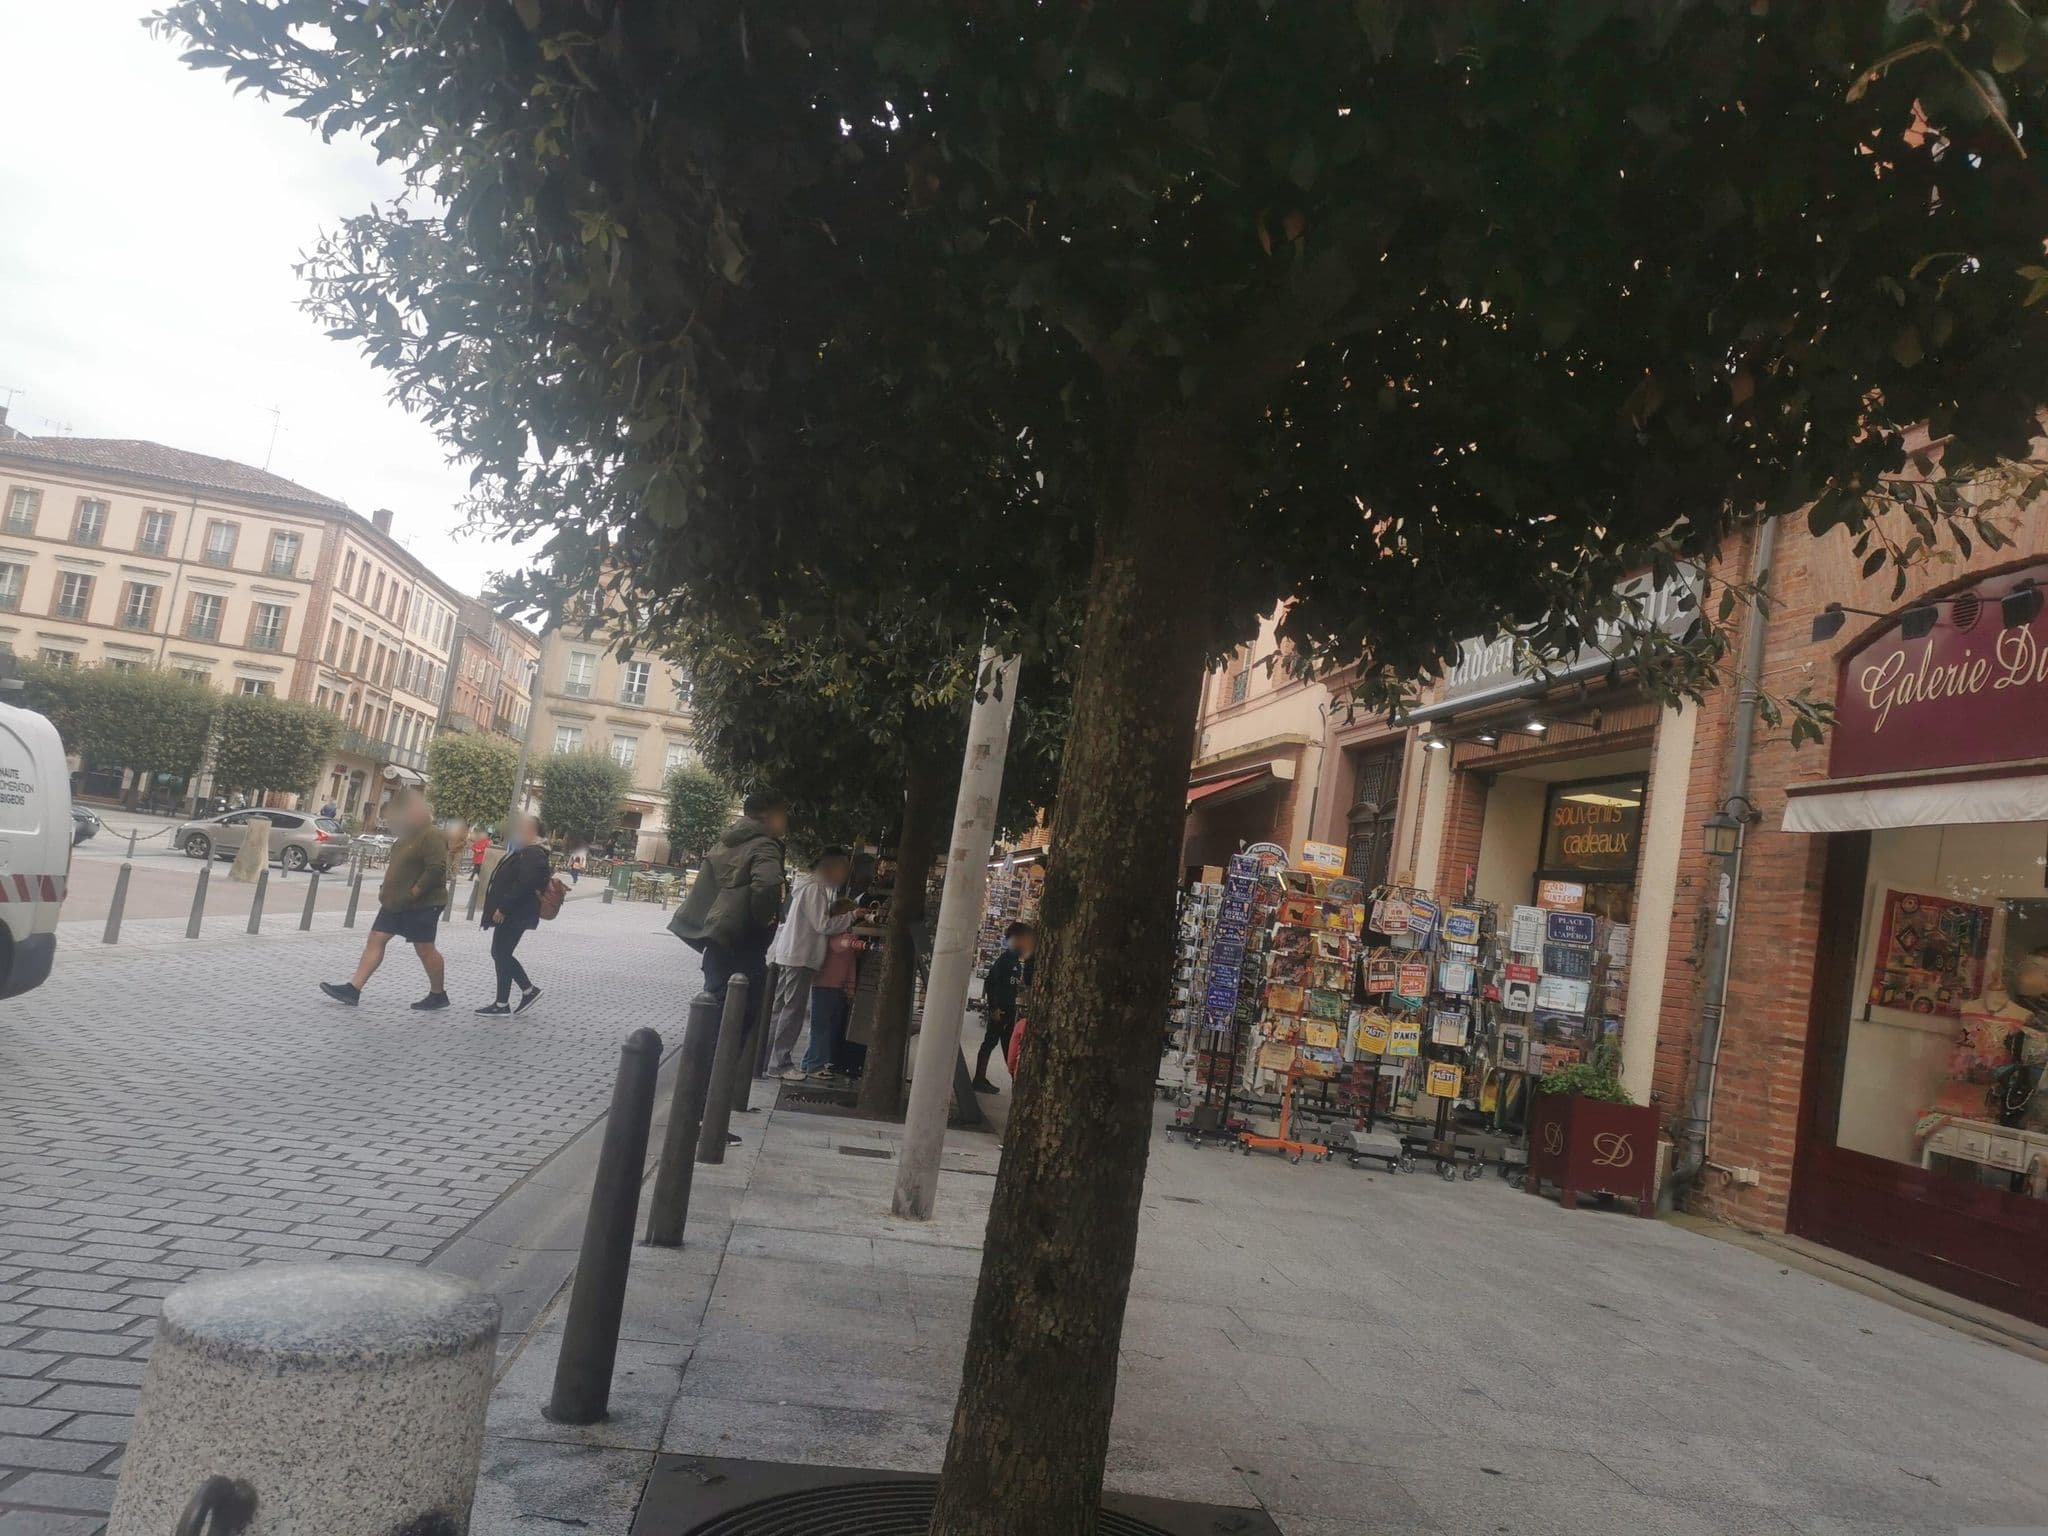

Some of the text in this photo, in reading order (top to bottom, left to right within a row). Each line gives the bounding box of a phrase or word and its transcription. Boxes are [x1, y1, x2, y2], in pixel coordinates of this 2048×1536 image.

[1861, 640, 1993, 733] Galerie
[1563, 825, 1630, 856] cadeaux
[1558, 917, 1585, 926] PLACE
[1592, 1132, 1634, 1168] D
